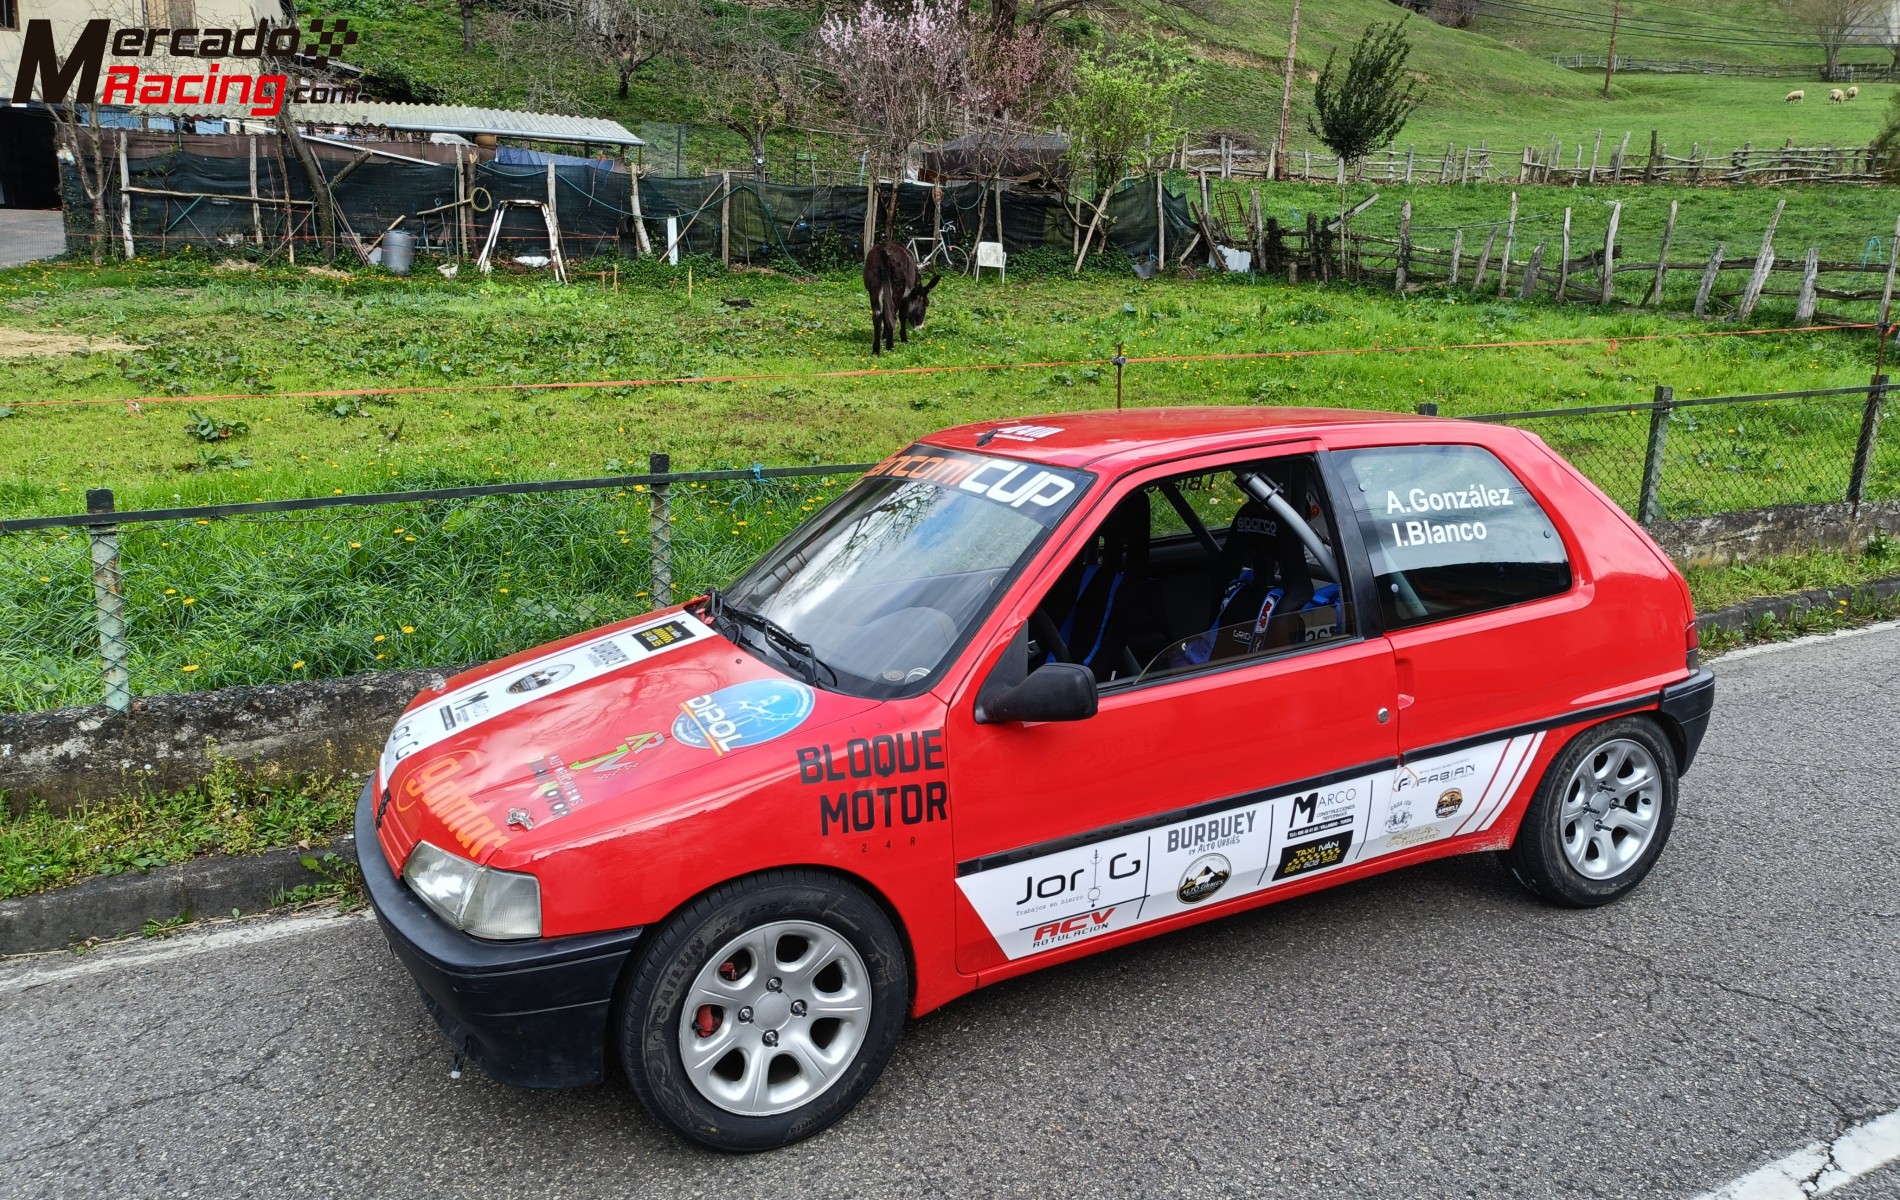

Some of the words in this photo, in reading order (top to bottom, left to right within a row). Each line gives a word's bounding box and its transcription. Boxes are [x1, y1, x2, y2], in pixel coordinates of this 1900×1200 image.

[1386, 484, 1513, 514] A.González
[1392, 520, 1488, 547] I.Blanco
[686, 694, 743, 752] DIPOL
[796, 729, 945, 784] BLOQUE
[1416, 764, 1475, 787] FABIAN
[820, 781, 947, 836] MOTOR
[1289, 788, 1357, 828] MARCO
[1167, 810, 1256, 853] BURBUEY
[1197, 843, 1216, 853] ALTO
[1295, 847, 1316, 857] TAXI
[1016, 868, 1084, 905] Jor
[1108, 852, 1141, 880] G
[1016, 903, 1047, 917] Trabajos
[1060, 894, 1084, 905] hierro
[1032, 922, 1109, 948] ROTULACION
[1033, 907, 1117, 941] ACV
